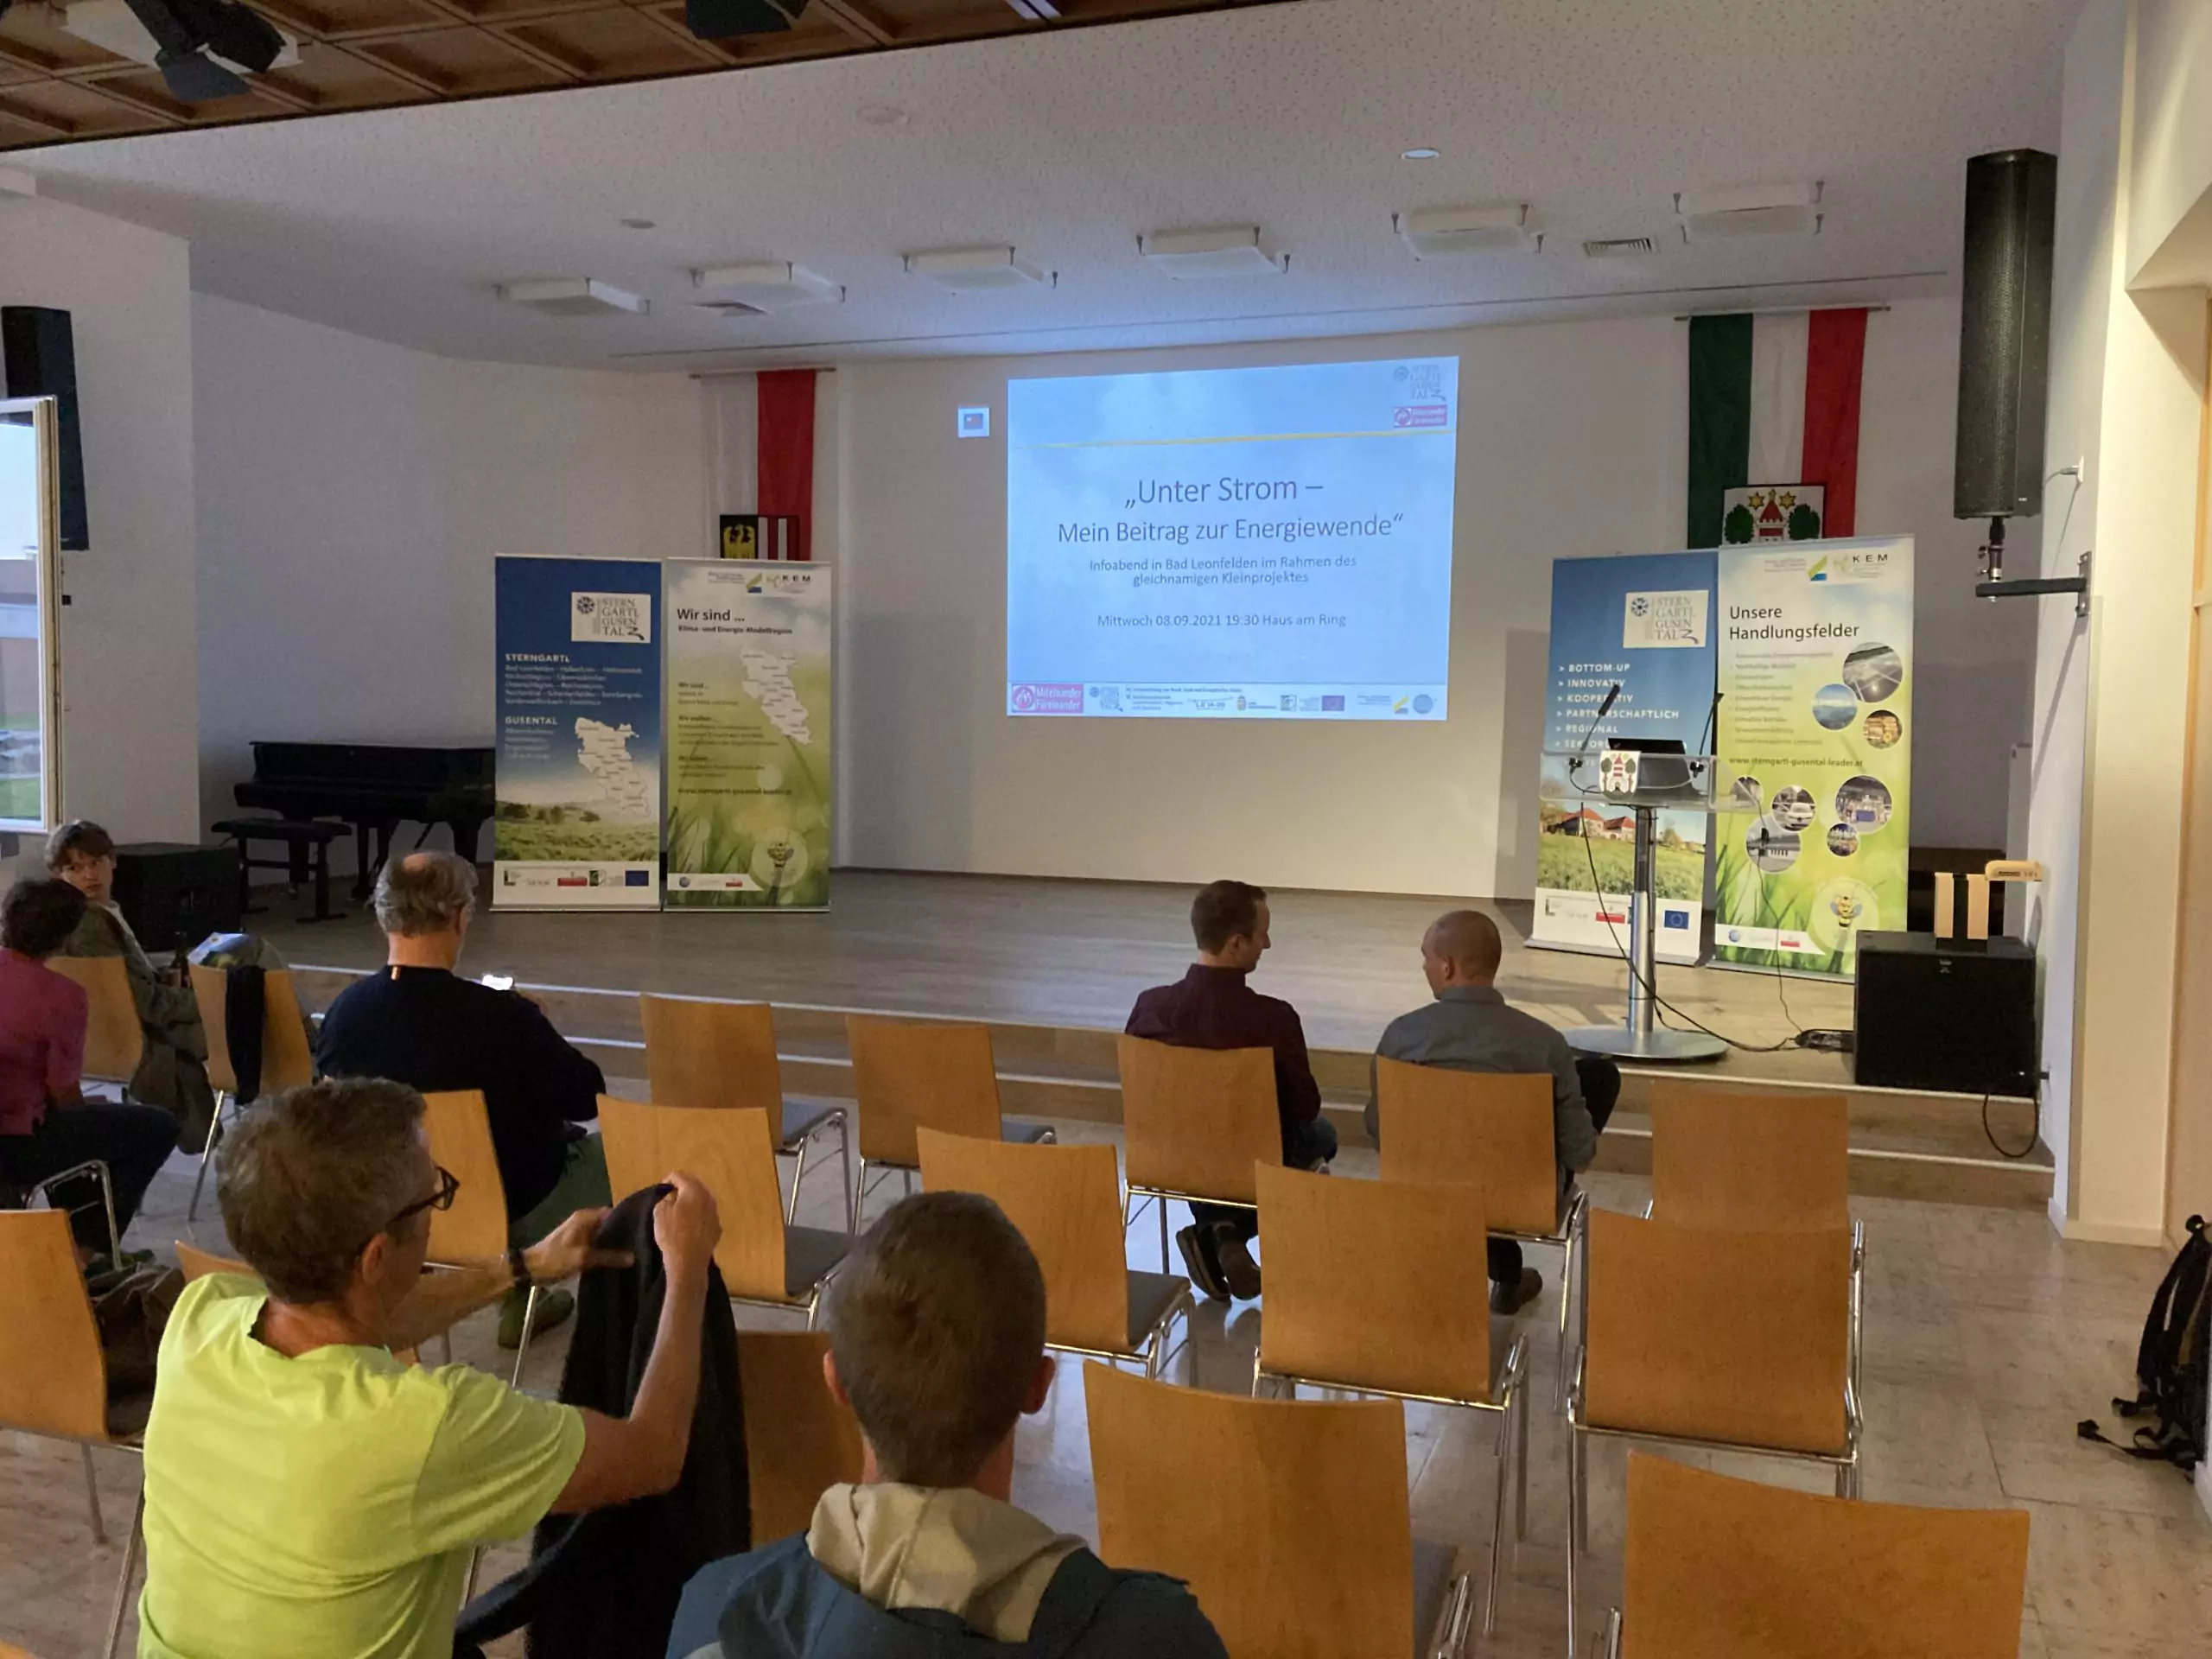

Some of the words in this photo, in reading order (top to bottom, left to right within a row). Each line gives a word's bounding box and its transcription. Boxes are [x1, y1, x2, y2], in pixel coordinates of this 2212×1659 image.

[1218, 477, 1298, 501] Strom
[1058, 523, 1109, 543] Mein
[1116, 522, 1189, 545] Beitrag
[1195, 523, 1229, 540] zur
[1090, 558, 1148, 571] Infoabend
[1151, 558, 1162, 570] in
[1166, 558, 1188, 570] Bad
[1191, 556, 1258, 570] Leonfelden
[1261, 556, 1277, 569] im
[1281, 556, 1332, 569] Rahmen
[1335, 555, 1357, 567] des
[1133, 573, 1219, 588] gleichnamigen
[1222, 570, 1309, 586] Kleinprojektes
[602, 598, 636, 607] STERN
[1656, 596, 1693, 607] STERN
[677, 608, 700, 621] Wir
[702, 608, 731, 622] sind
[1730, 606, 1783, 620] Unsere
[601, 617, 637, 626] GUSEN
[1097, 614, 1153, 627] Mittwoch
[1155, 614, 1221, 626] 08.09.2021
[1225, 614, 1260, 626] 19:30
[1262, 614, 1293, 626] Haus
[1295, 616, 1315, 626] am
[1319, 614, 1347, 627] Ring
[602, 626, 626, 636] TAL
[1656, 629, 1679, 640] TAL
[1729, 622, 1860, 642] Handlungsfelder
[505, 653, 570, 664] STERNGARTL
[1568, 664, 1630, 673] BOTTOM-UP
[1567, 694, 1634, 703] KOOPETIV
[1566, 709, 1679, 719] PARTNRSCHAFTLICH
[505, 715, 558, 726] GUSENTAL
